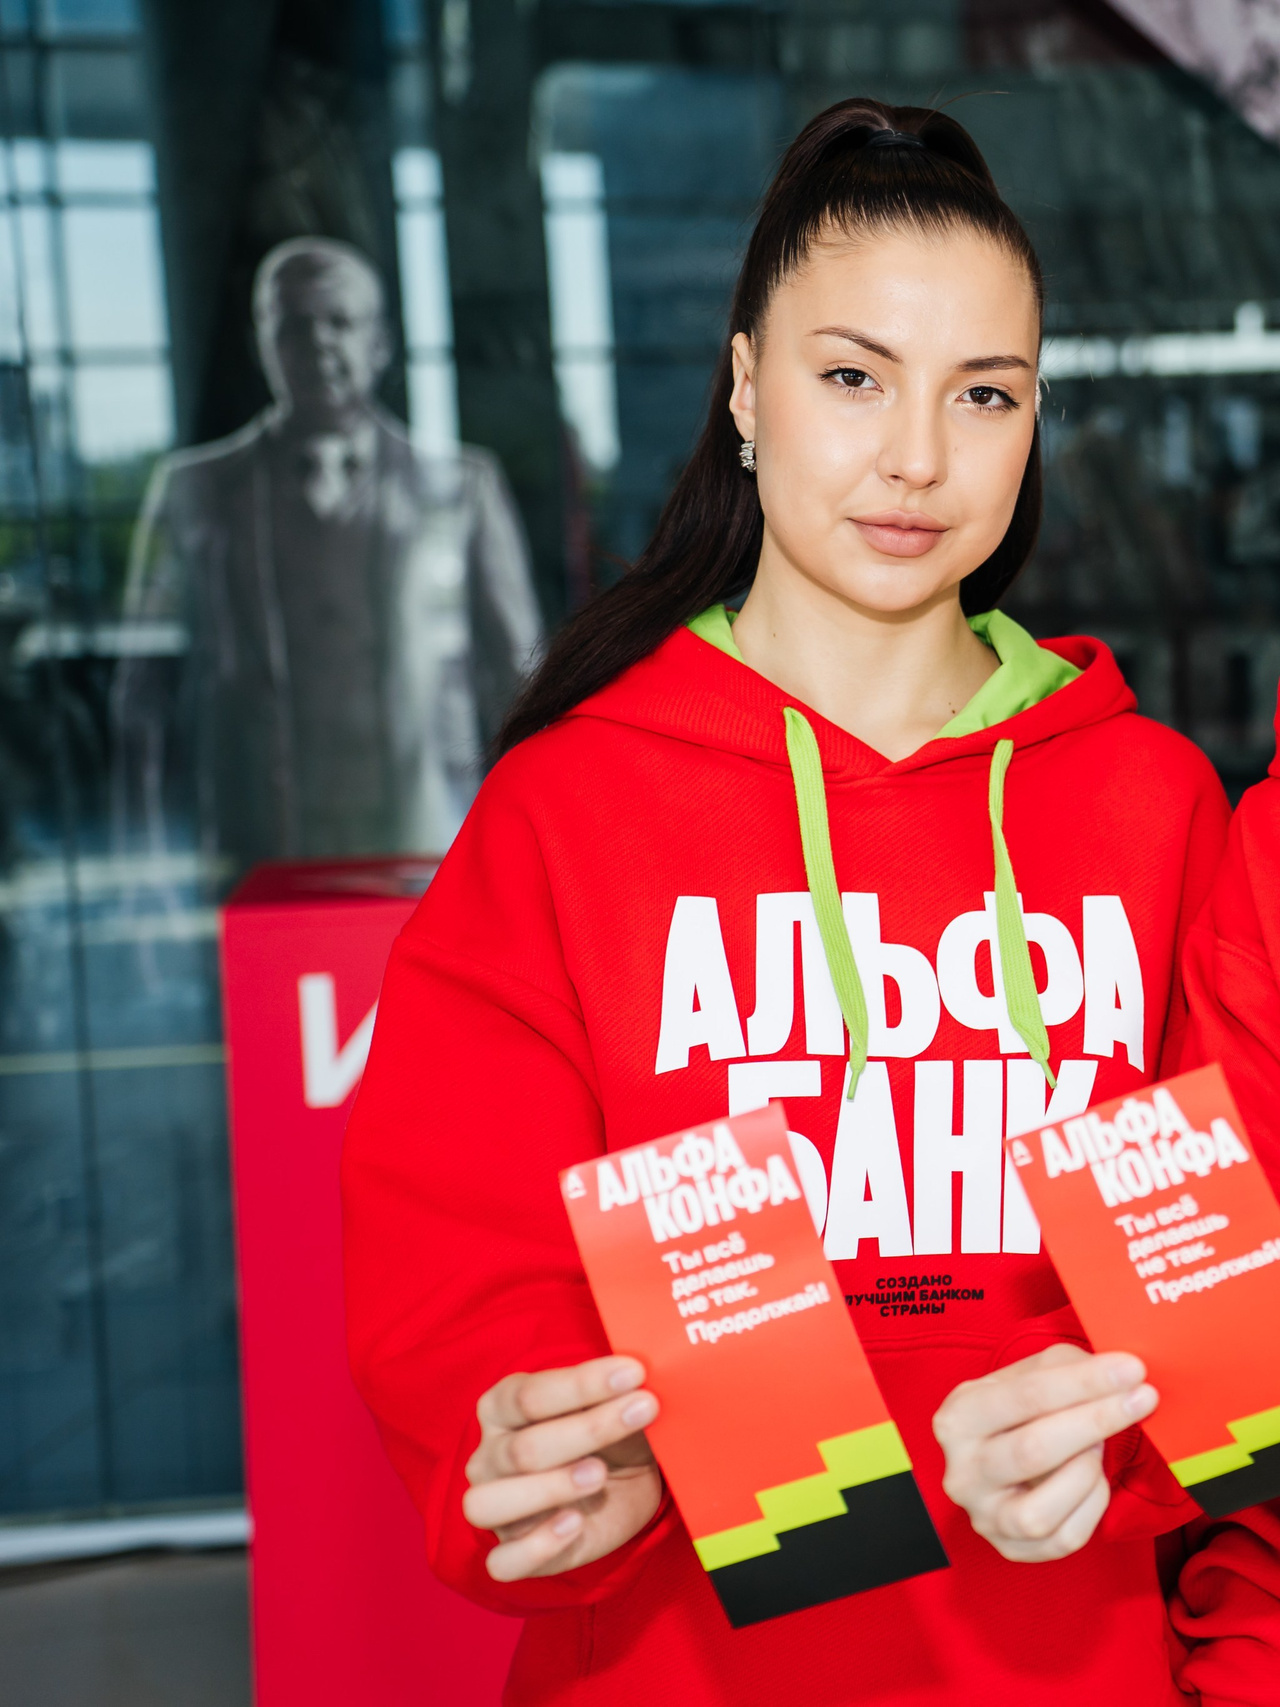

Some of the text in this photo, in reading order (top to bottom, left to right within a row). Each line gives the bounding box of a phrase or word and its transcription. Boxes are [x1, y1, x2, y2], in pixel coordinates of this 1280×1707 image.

[655, 891, 1145, 1074] АЛЬФА
[1040, 1087, 1192, 1178] АЛЬФА
[596, 1122, 746, 1212] АЛЬФА
[1090, 1117, 1249, 1208] КОНФА
[643, 1154, 801, 1243] КОНФА
[1114, 1193, 1199, 1237] Ты всё
[661, 1231, 746, 1274] Ты всё
[1127, 1213, 1229, 1262] делаешь
[1135, 1241, 1215, 1278] не так.
[671, 1253, 775, 1300] делаешь
[677, 1281, 758, 1318] не так.
[875, 1274, 953, 1290] СОЗДАНО
[919, 1288, 985, 1302] БАНКОМ
[685, 1281, 831, 1345] Продолжай!
[879, 1302, 946, 1317] СТРАНЫ
